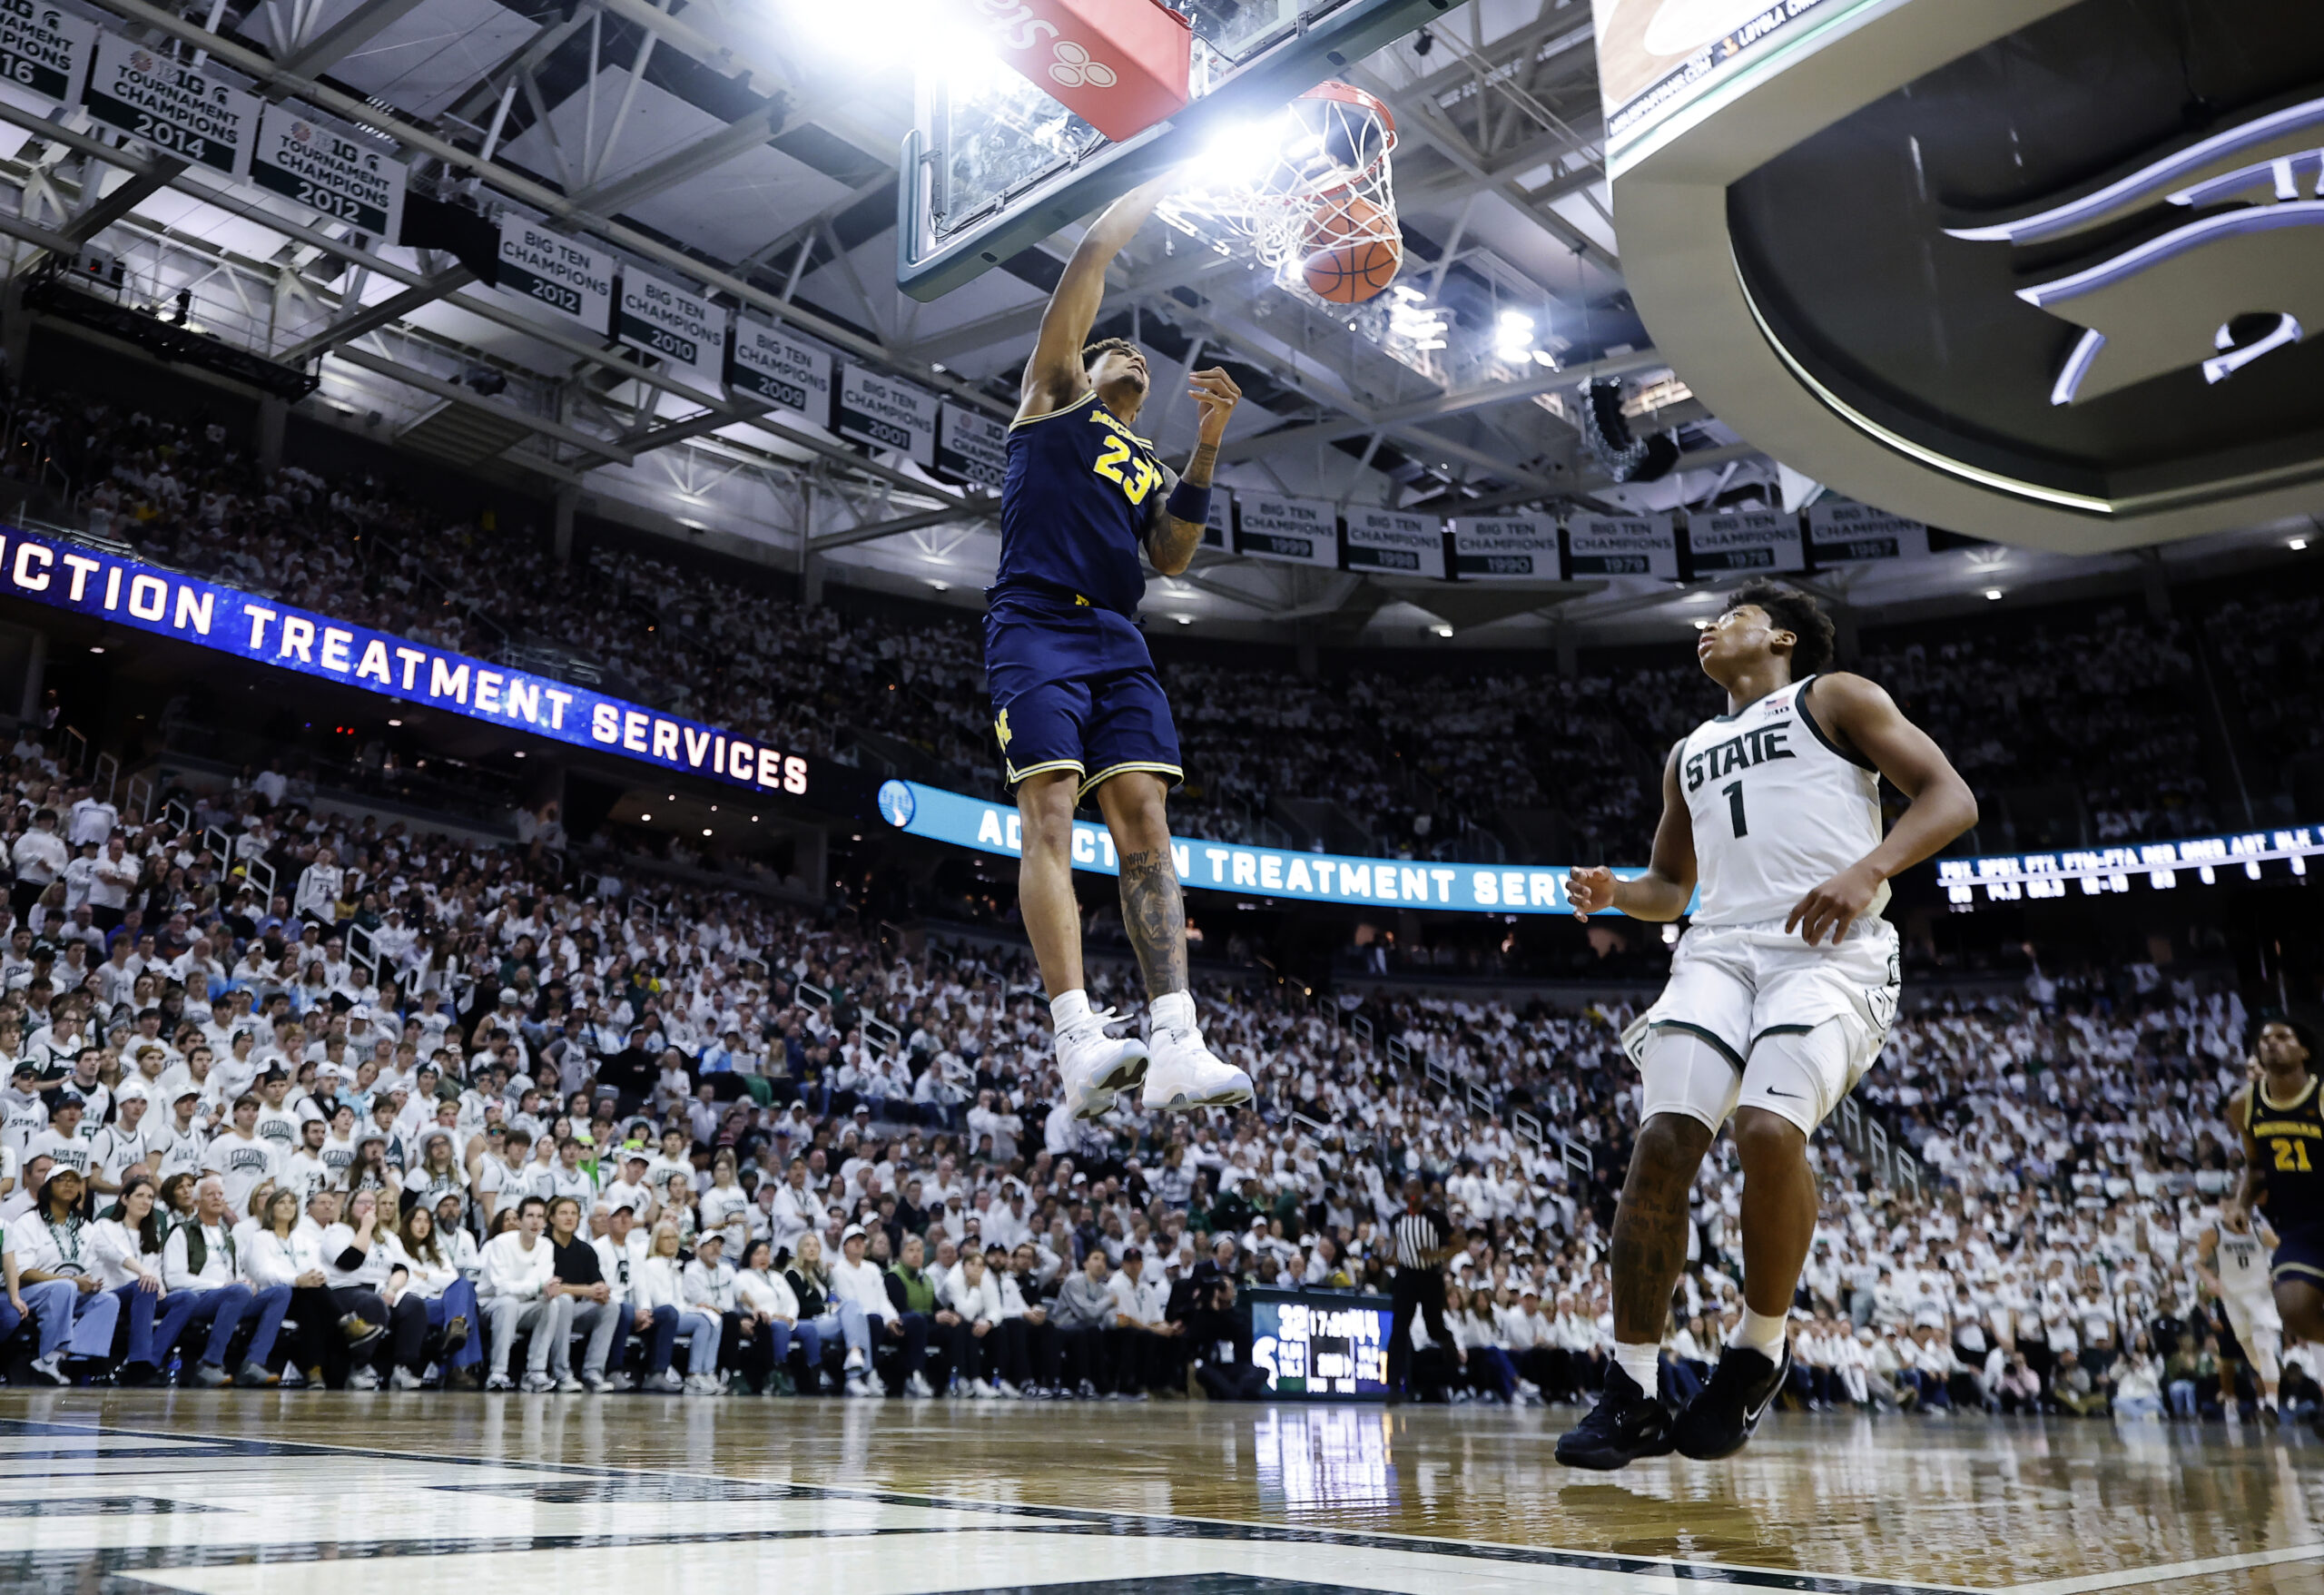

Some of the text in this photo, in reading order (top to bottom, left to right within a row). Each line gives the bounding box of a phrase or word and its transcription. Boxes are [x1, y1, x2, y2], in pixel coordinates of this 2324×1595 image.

[0, 12, 74, 52] AMENT
[0, 30, 72, 70] PIONS
[113, 81, 238, 143] CHAMPIONS
[117, 64, 241, 126] TOURNAMENT
[133, 113, 205, 160] 2014
[276, 151, 389, 208] CHAMPIONS
[280, 135, 390, 191] TOURNAMENT
[296, 182, 360, 223] 2012
[524, 231, 590, 270] BIG TEN
[503, 241, 608, 297] CHAMPIONS
[531, 279, 578, 311] 2012
[645, 284, 705, 320] BIG TEN
[625, 294, 723, 346] CHAMPIONS
[651, 330, 694, 360] 2010
[755, 333, 812, 368] BIG TEN
[737, 345, 827, 392] CHAMPIONS
[758, 377, 804, 408] 2009
[862, 379, 918, 410] BIG TEN
[844, 389, 932, 433] CHAMPIONS
[869, 419, 908, 448] 2001
[1093, 434, 1154, 506] 23
[1243, 515, 1334, 537] CHAMPIONS
[1259, 502, 1316, 520] BIG TEN
[1365, 514, 1423, 532] BIG TEN
[1474, 522, 1536, 536] BIG TEN
[1590, 522, 1652, 536] BIG TEN
[1710, 515, 1777, 532] BIG TEN
[1350, 527, 1441, 550] CHAMPIONS
[1459, 537, 1557, 551] CHAMPIONS
[1573, 537, 1674, 551] CHAMPIONS
[1694, 527, 1798, 547] CHAMPIONS
[242, 604, 573, 731] TREATMENT
[591, 703, 808, 795] SERVICES
[1685, 721, 1797, 793] STATE
[1722, 780, 1748, 839] 1
[1126, 849, 1149, 865] WHY
[1206, 848, 1456, 903] TREATMENT
[2270, 1137, 2313, 1172] 21
